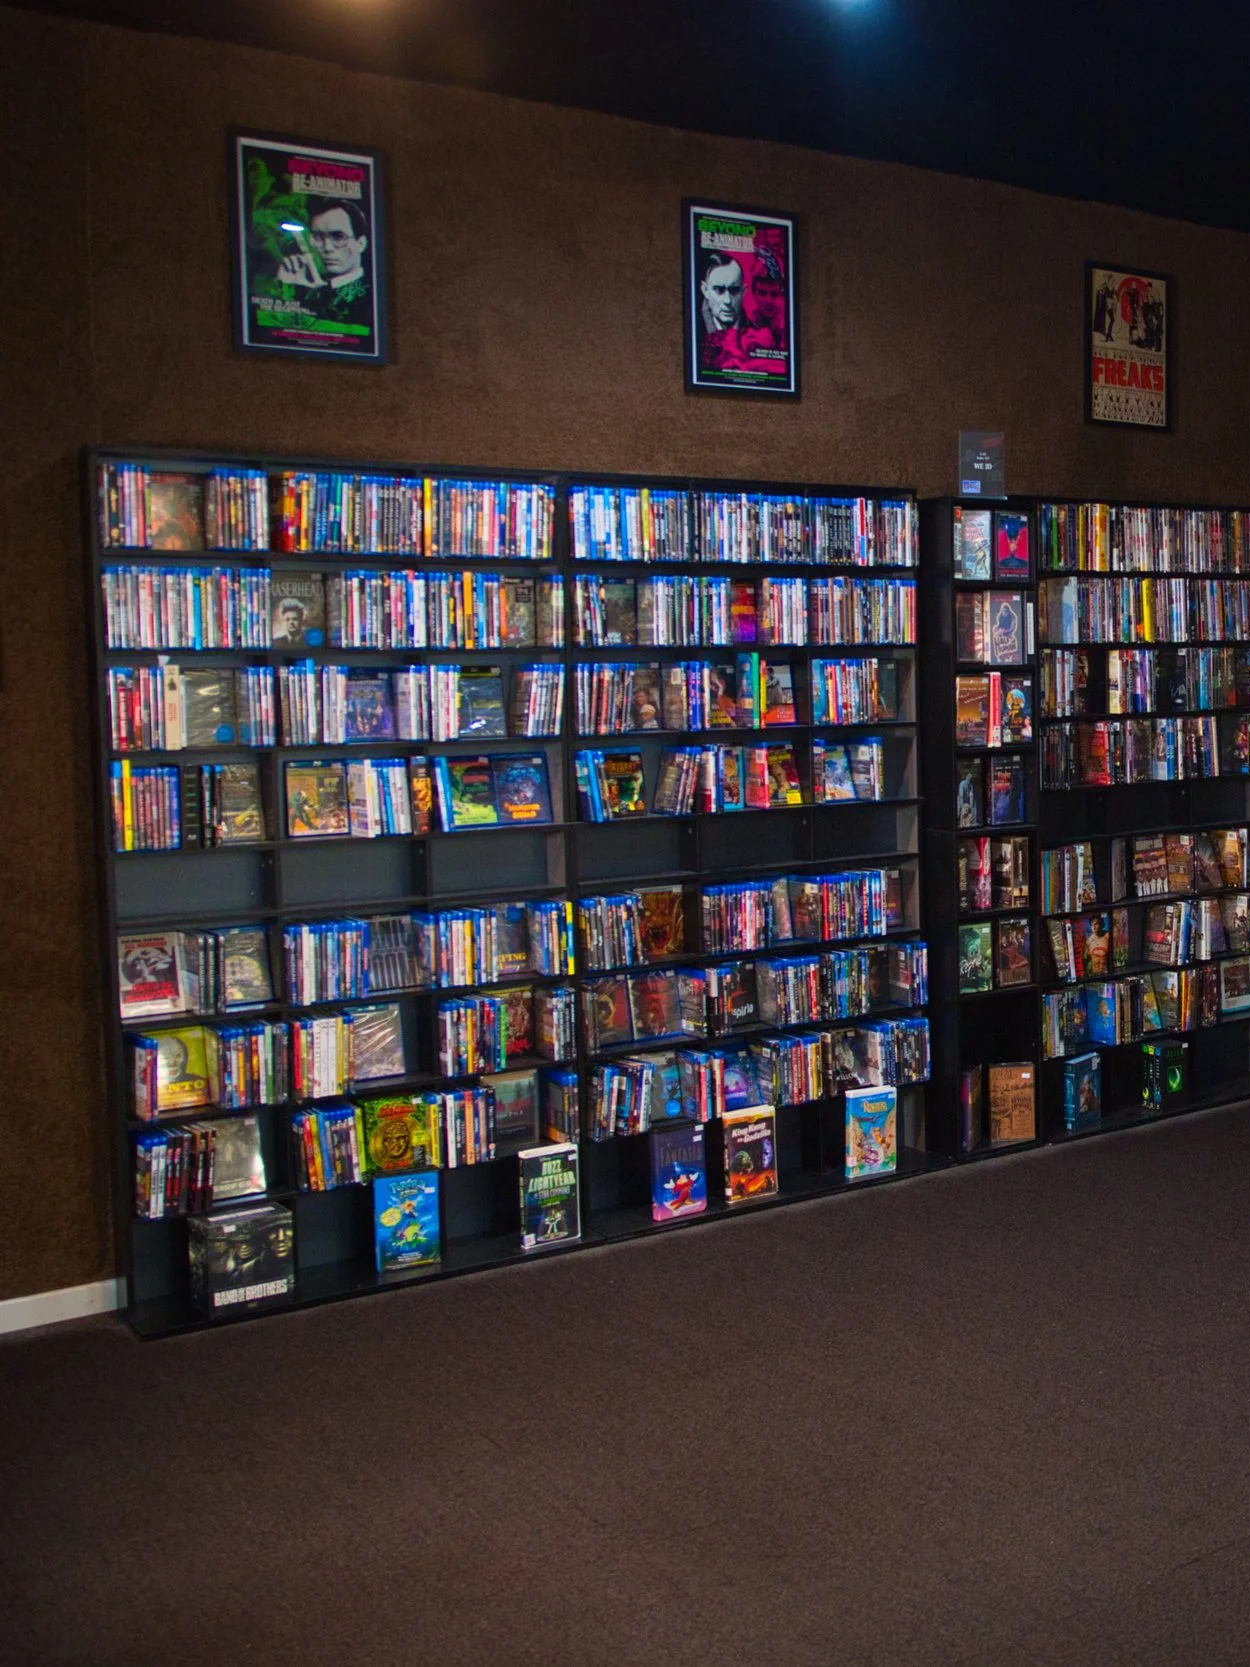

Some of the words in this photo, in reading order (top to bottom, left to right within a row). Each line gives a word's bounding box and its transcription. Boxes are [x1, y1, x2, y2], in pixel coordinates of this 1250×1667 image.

[288, 160, 364, 182] BEYOND
[292, 173, 362, 196] RE-ANIMATOR
[698, 218, 757, 238] BEYOND
[701, 231, 755, 249] RE-ANIMATOR
[1092, 356, 1165, 393] FREAKS
[270, 579, 324, 598] RASERHEAD
[541, 1158, 562, 1175] BUZZ
[660, 1146, 703, 1166] FANTASIA
[528, 1171, 576, 1193] LIGHTYEAR
[213, 1288, 238, 1307] BAND
[245, 1278, 288, 1300] BROTHERS
